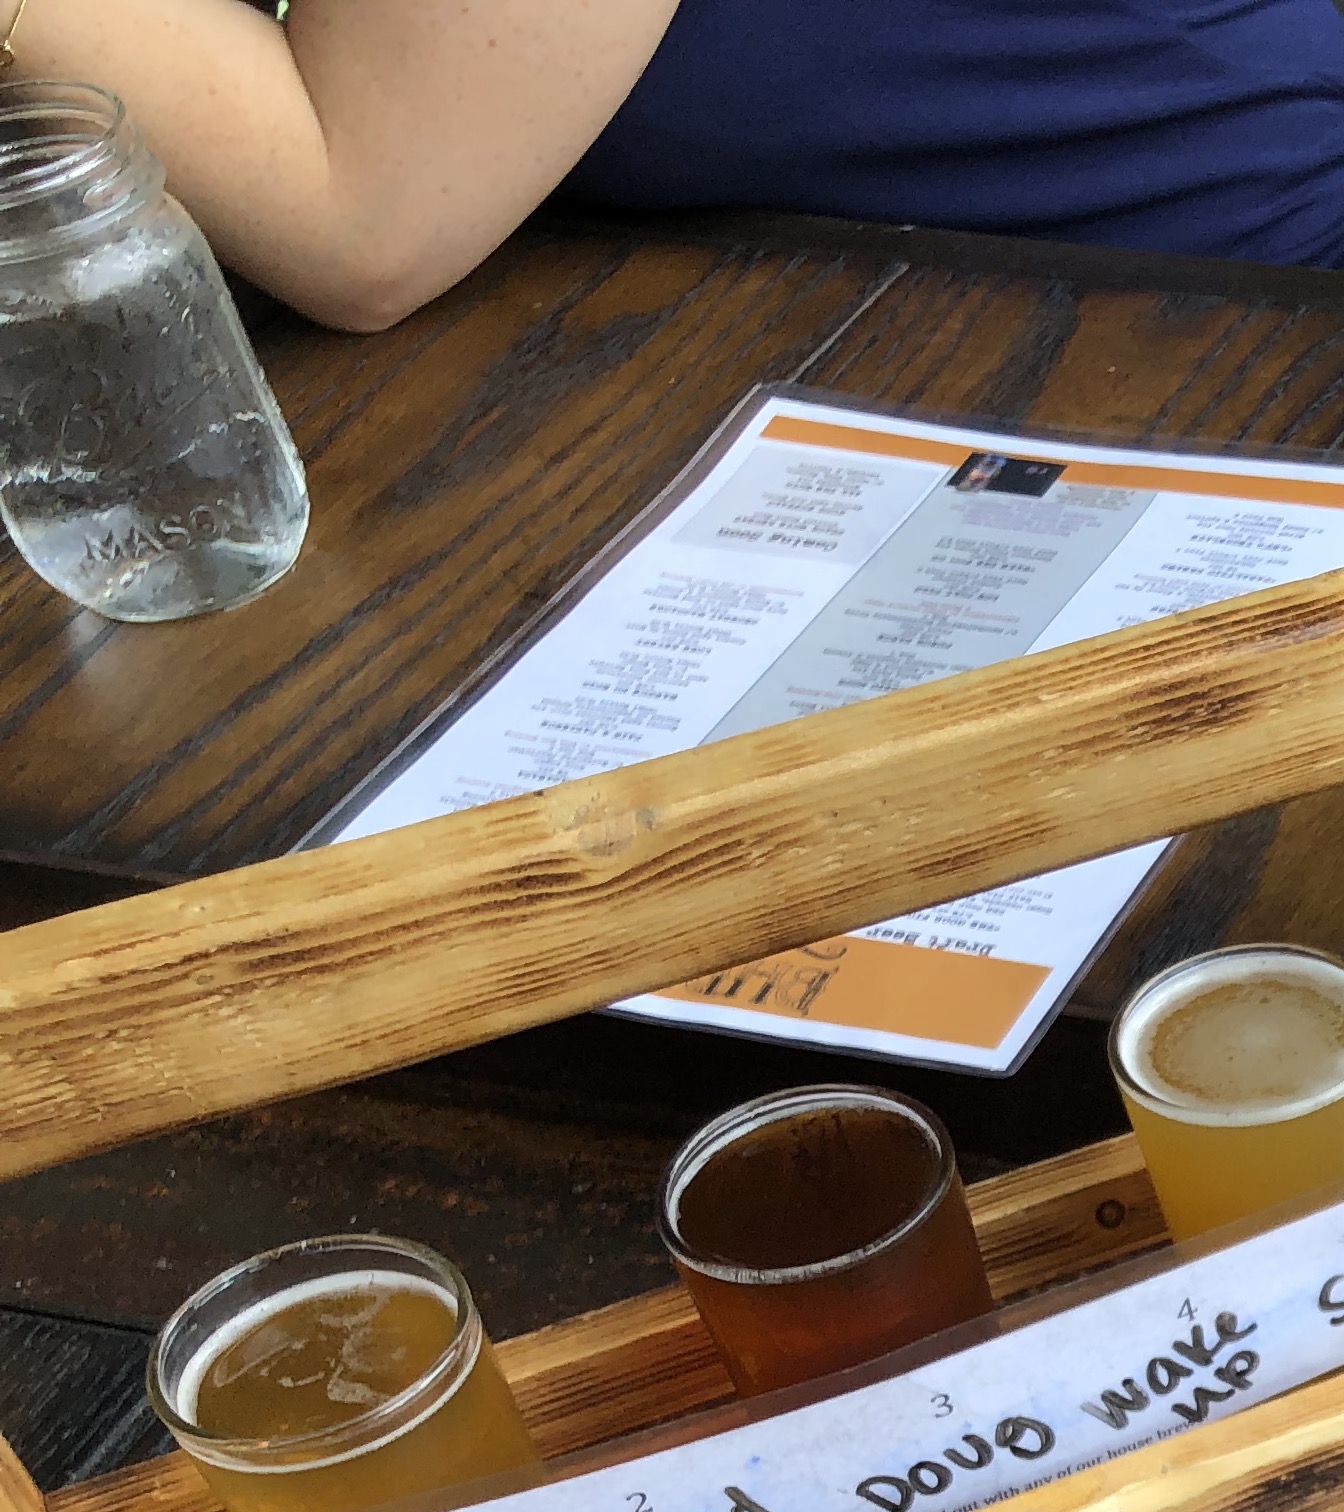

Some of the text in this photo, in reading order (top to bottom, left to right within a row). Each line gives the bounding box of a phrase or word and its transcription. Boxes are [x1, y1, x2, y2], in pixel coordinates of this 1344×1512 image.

[1177, 1297, 1198, 1322] 4
[931, 1393, 954, 1418] 3
[984, 1485, 1021, 1508] with
[1024, 1473, 1052, 1493] any
[1107, 1435, 1155, 1460] house
